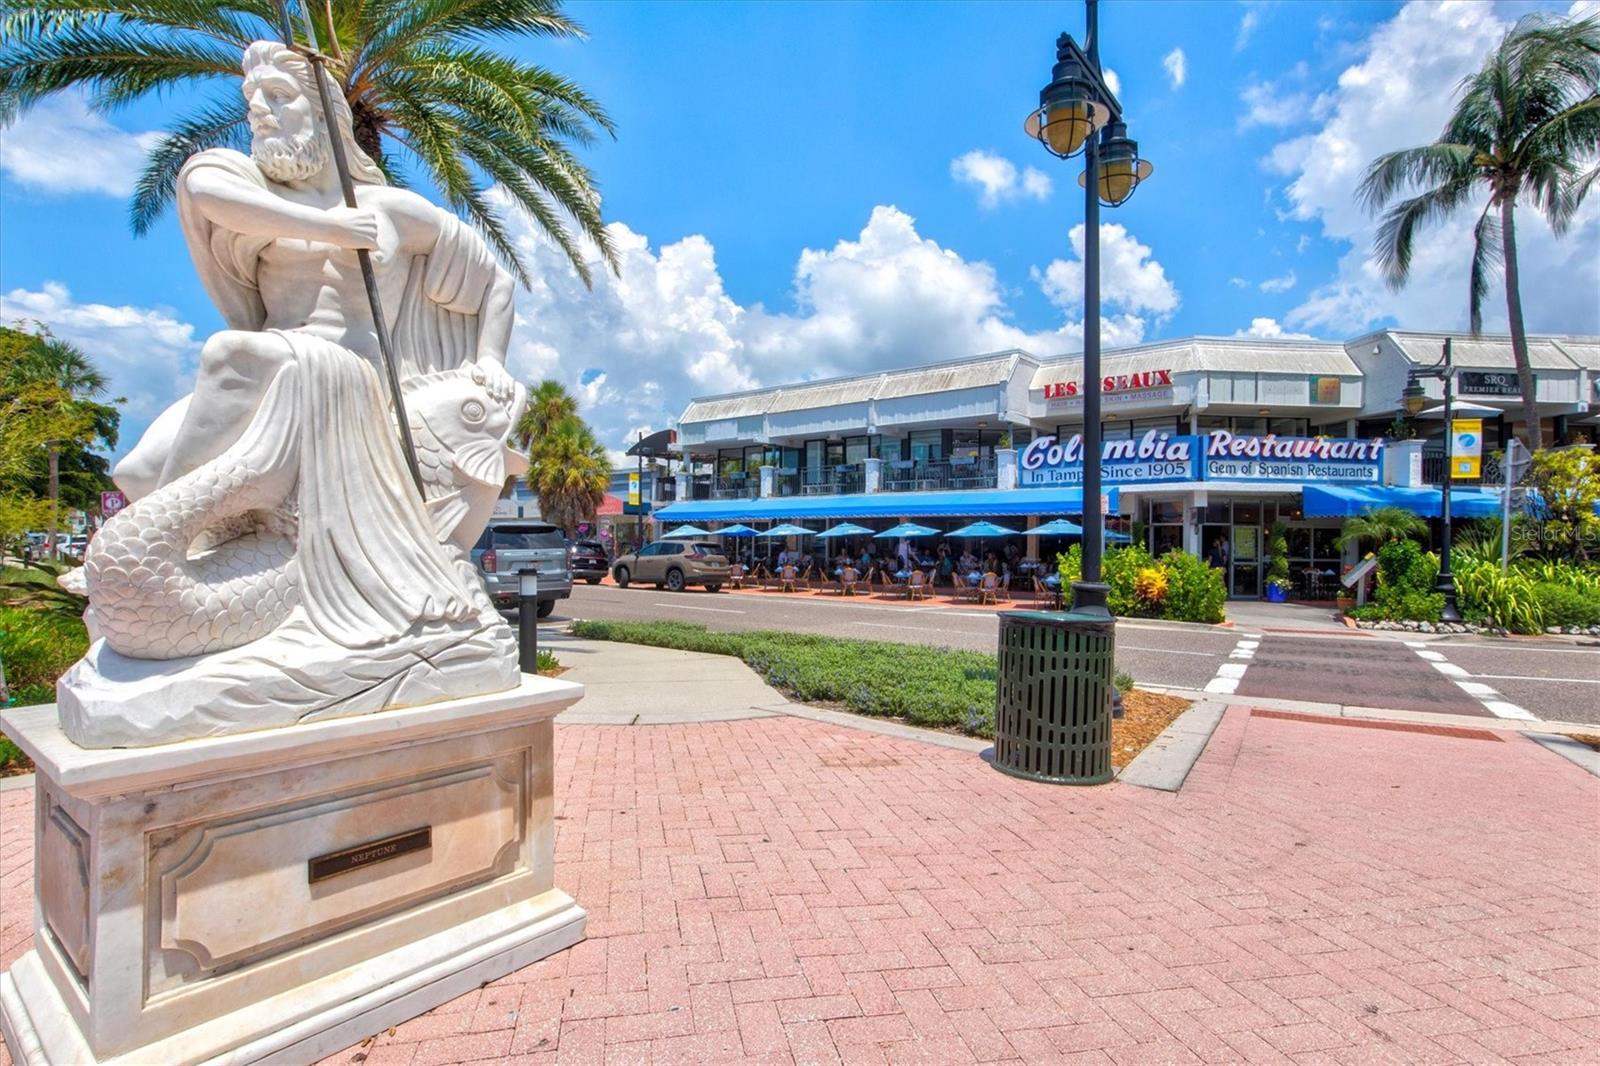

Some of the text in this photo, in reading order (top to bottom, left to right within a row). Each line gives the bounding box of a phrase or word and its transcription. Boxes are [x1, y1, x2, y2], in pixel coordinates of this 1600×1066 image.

[1044, 369, 1172, 399] LES SEAUX
[1463, 386, 1500, 394] PREMIER
[1483, 374, 1509, 387] SRQ
[1130, 390, 1169, 400] MASSAGE
[1021, 429, 1190, 470] Colmbia
[1209, 430, 1384, 460] Restaurant
[1031, 462, 1186, 483] In Tamp Since 1905
[1209, 461, 1374, 478] Gem of Spanish Restaurants
[351, 844, 397, 863] NEPTUNE
